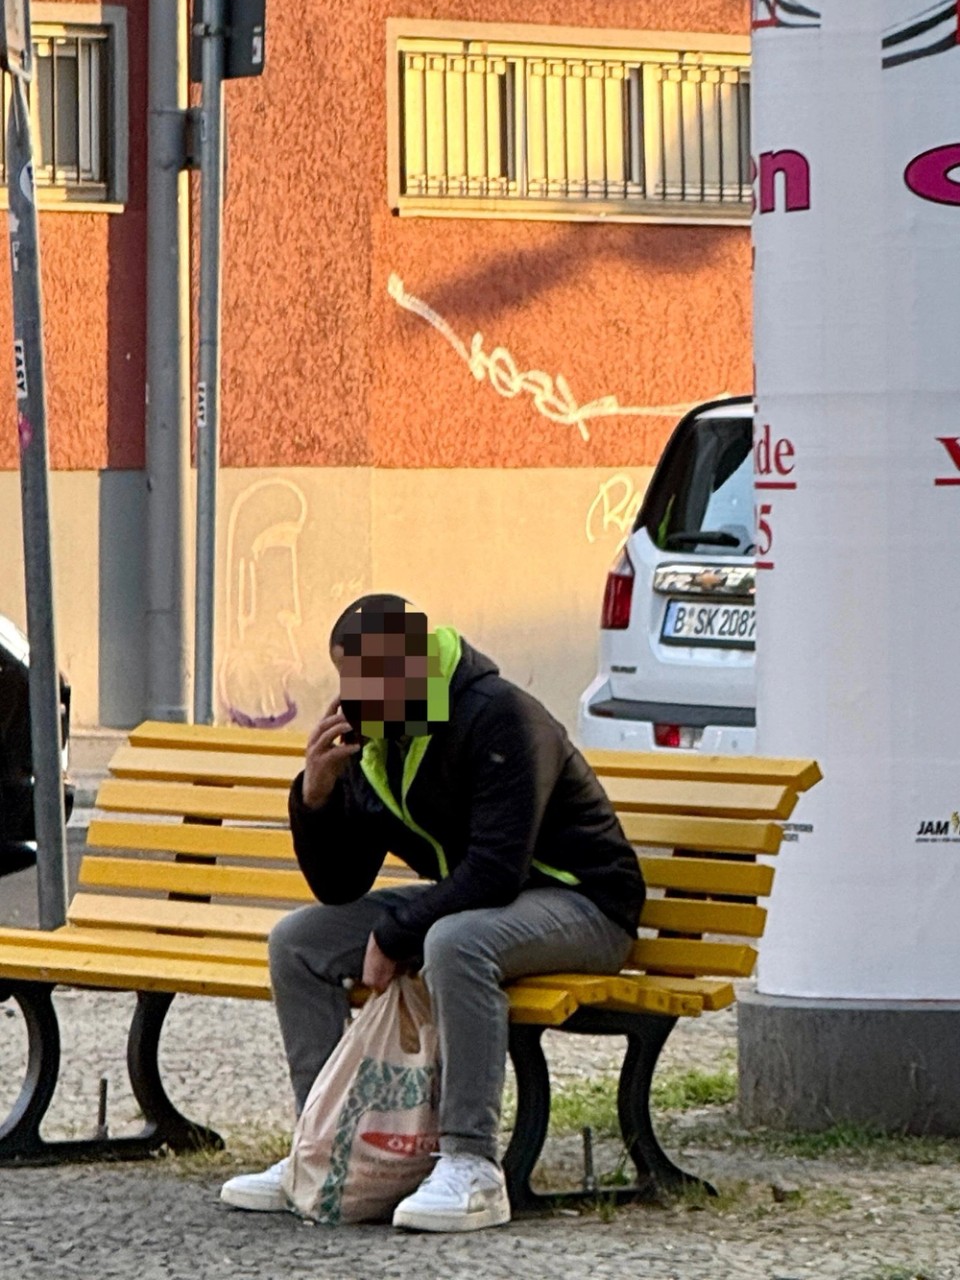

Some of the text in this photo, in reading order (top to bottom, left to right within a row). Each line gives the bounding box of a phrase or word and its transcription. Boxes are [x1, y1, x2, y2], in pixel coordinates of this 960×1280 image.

[673, 606, 687, 634] B
[694, 607, 720, 636] SK
[916, 820, 950, 836] JAM
